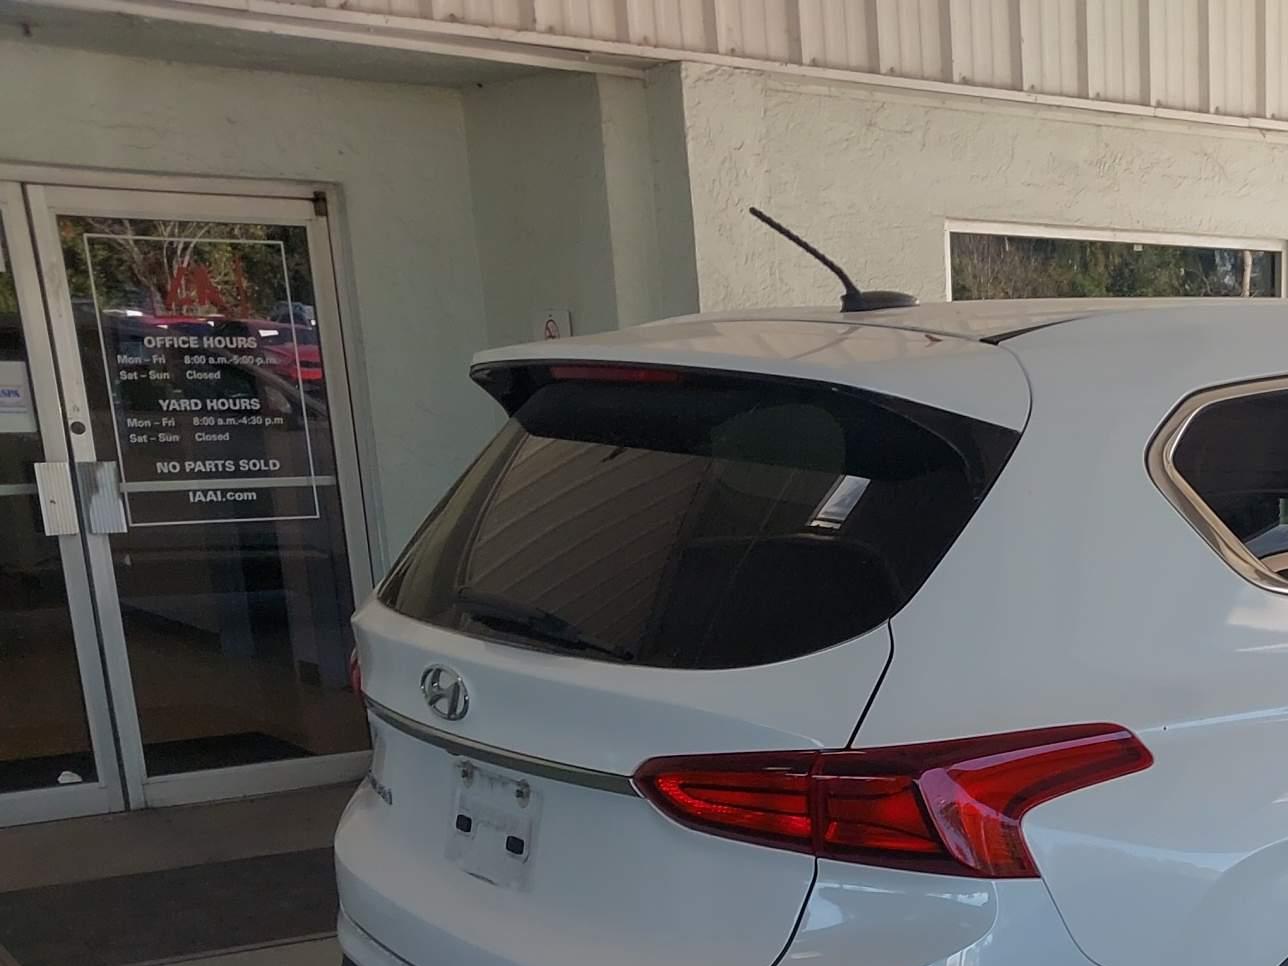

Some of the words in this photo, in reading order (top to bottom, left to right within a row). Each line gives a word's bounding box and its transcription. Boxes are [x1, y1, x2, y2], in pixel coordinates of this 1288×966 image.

[144, 336, 199, 348] OFFICE
[203, 336, 257, 348] HOURS
[117, 355, 142, 365] Mon
[152, 355, 166, 365] Fri
[184, 355, 206, 365] 8:00
[119, 370, 138, 380] Sat
[149, 370, 170, 380] Sun
[186, 370, 221, 380] Closed
[159, 399, 202, 411] YARD
[206, 398, 261, 410] HOURS
[127, 418, 151, 428] Mon
[162, 417, 176, 427] Fri
[192, 416, 215, 426] 8:00
[129, 433, 147, 443] Sat
[158, 433, 180, 442] Sun
[195, 432, 230, 442] Closed
[156, 462, 180, 473] NO
[185, 460, 235, 473] PARTS
[239, 460, 280, 471] SOLD
[189, 491, 257, 503] IAAI.com
